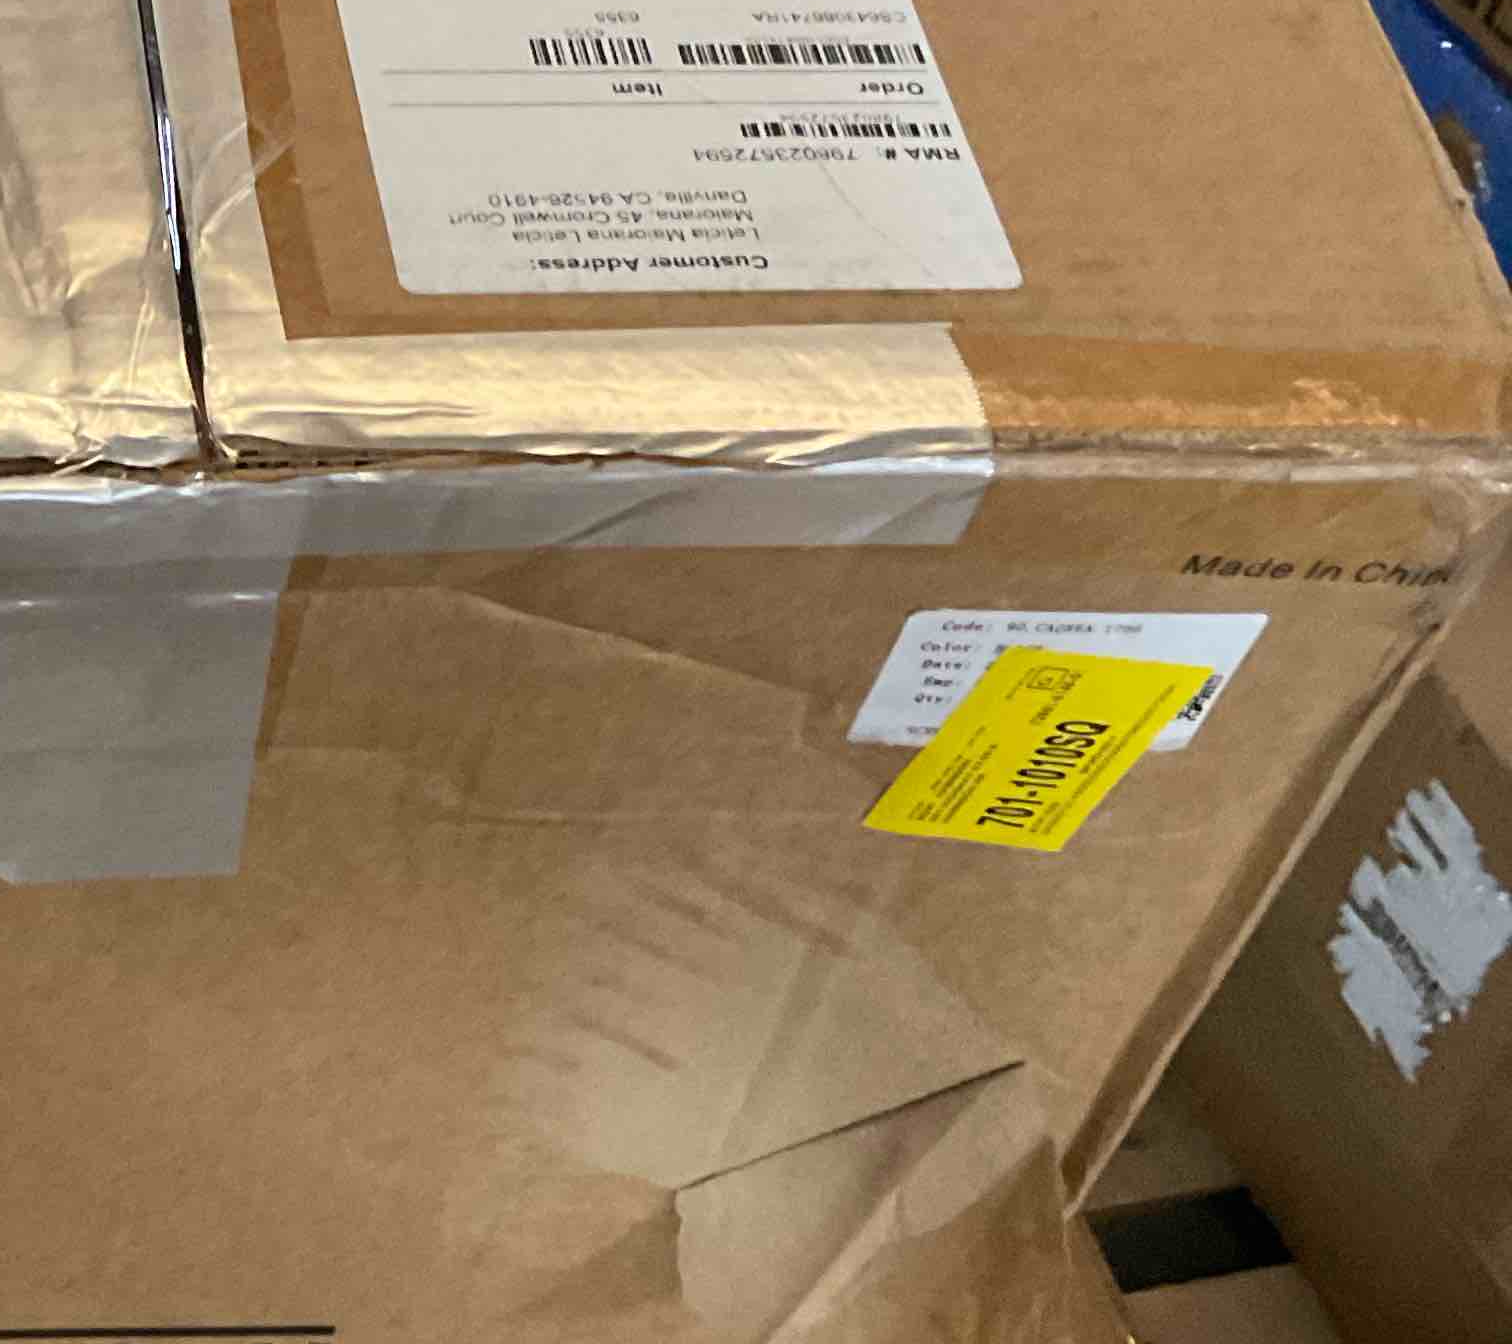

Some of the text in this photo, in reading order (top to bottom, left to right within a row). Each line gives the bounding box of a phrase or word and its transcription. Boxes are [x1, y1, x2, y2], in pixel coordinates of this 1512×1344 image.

[611, 81, 926, 97] Order Item
[904, 146, 961, 161] RMA
[618, 191, 651, 206] CA
[447, 212, 506, 226] Court
[512, 211, 611, 226] Cromwell
[615, 210, 643, 224] 45
[511, 230, 581, 244] Leticia
[528, 255, 769, 273] Customer Address:
[1180, 554, 1295, 580] Made
